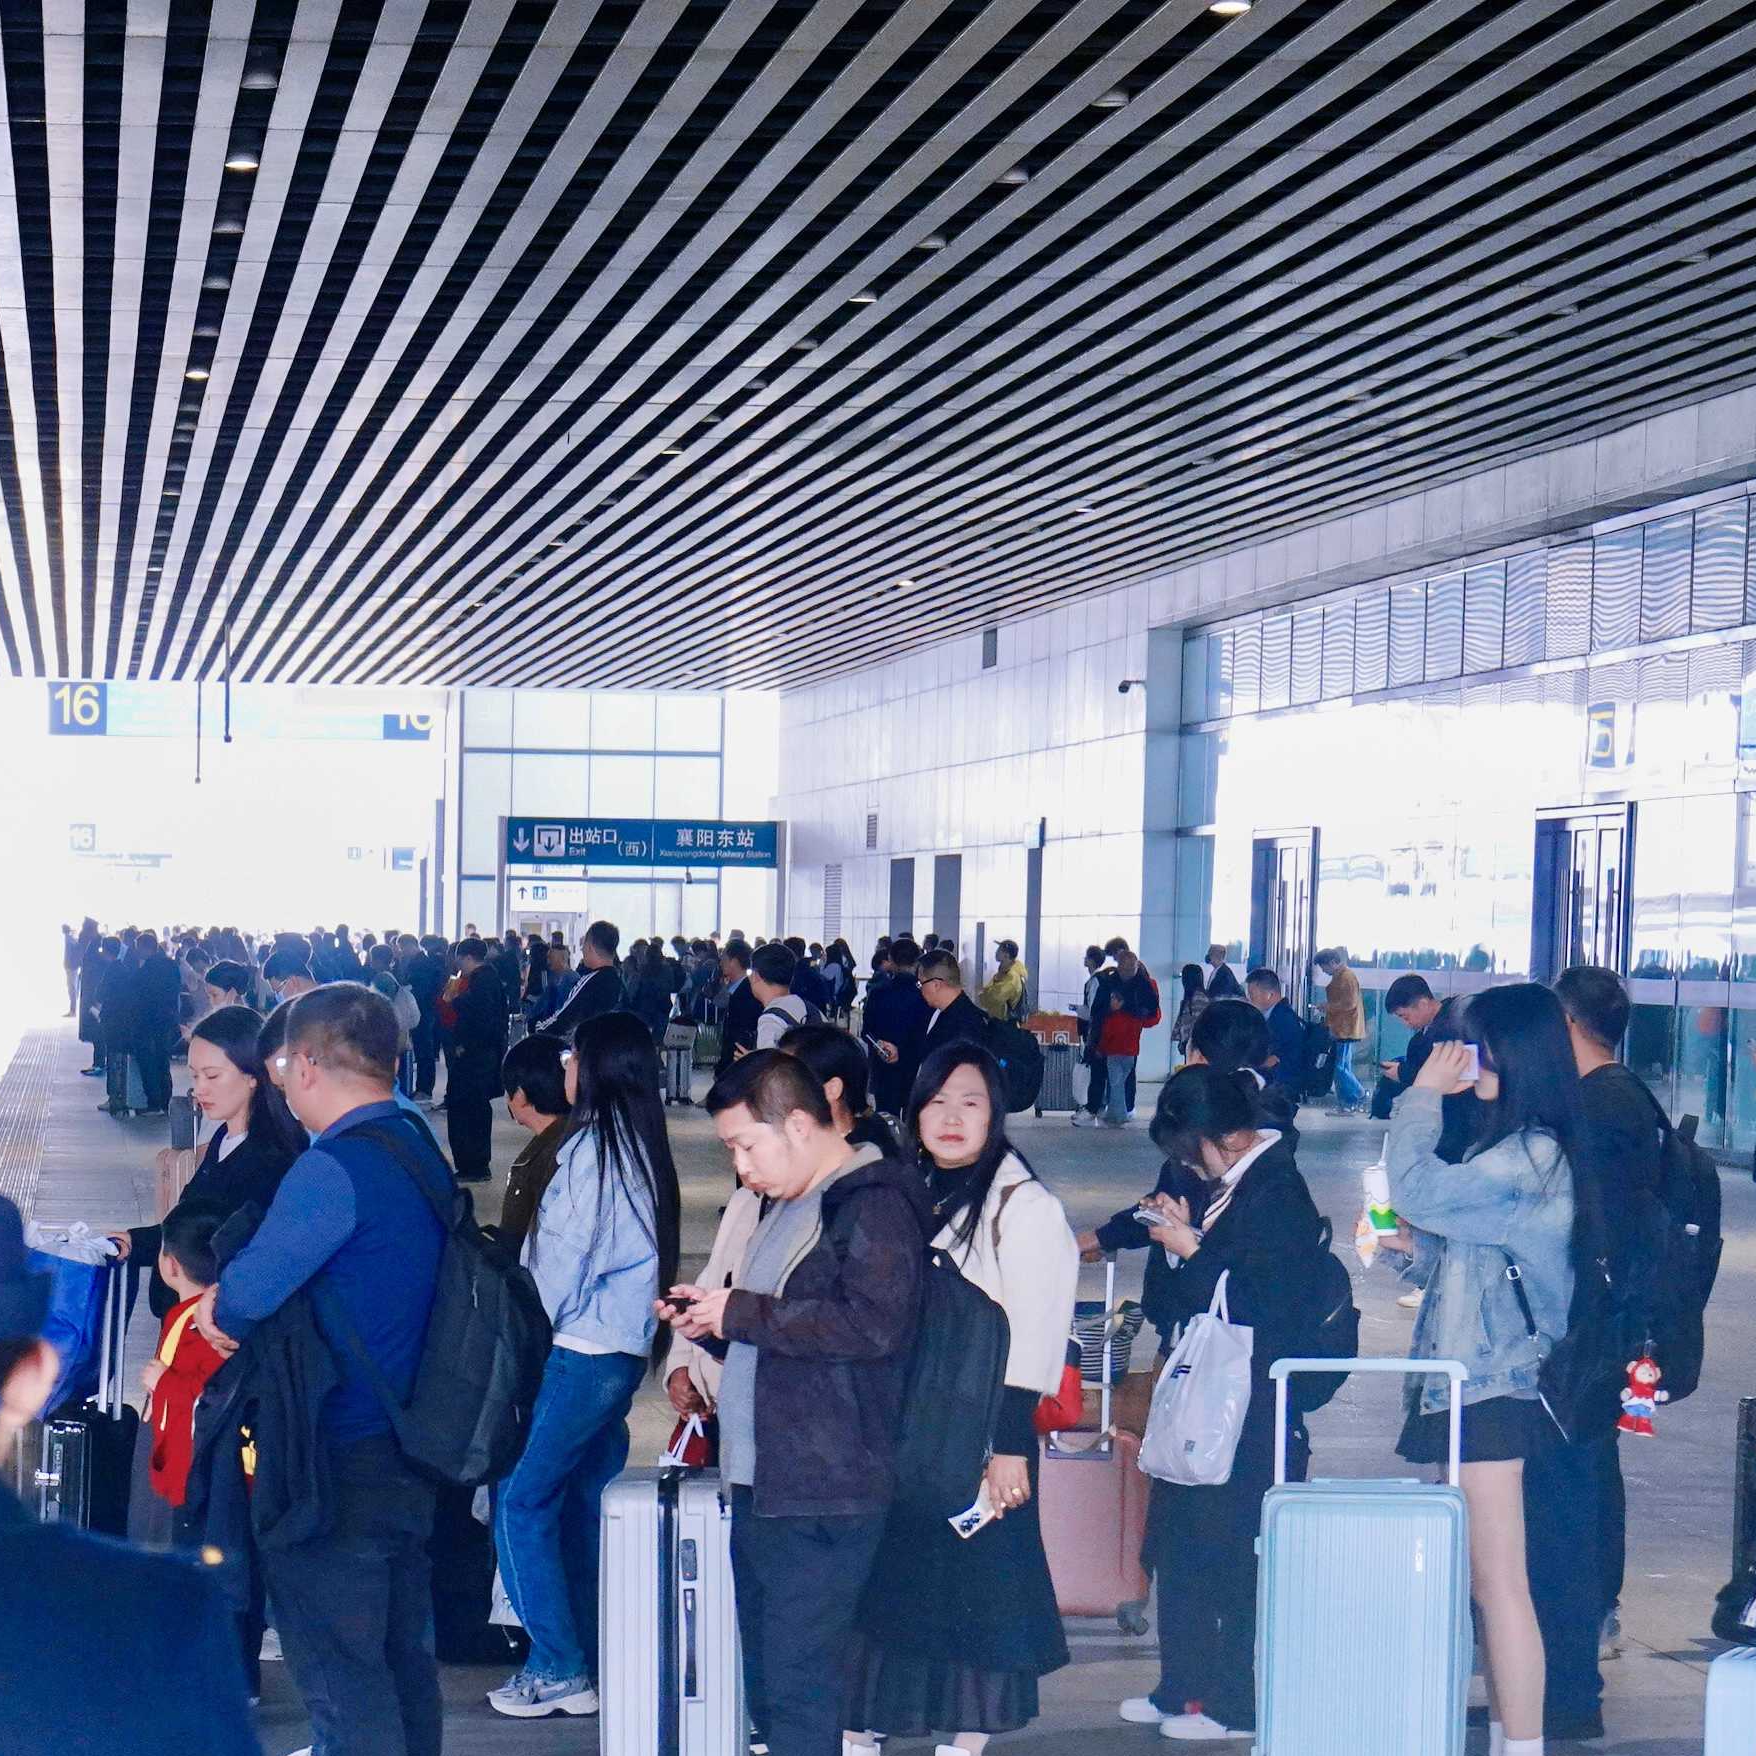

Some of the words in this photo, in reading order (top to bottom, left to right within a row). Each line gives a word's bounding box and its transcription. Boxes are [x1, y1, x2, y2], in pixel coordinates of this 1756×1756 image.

[54, 685, 100, 725] 16
[569, 826, 617, 844] 出站口
[676, 828, 755, 848] 襄阳东站
[569, 846, 586, 857] Exit
[716, 849, 744, 859] Railway
[746, 850, 772, 858] Station
